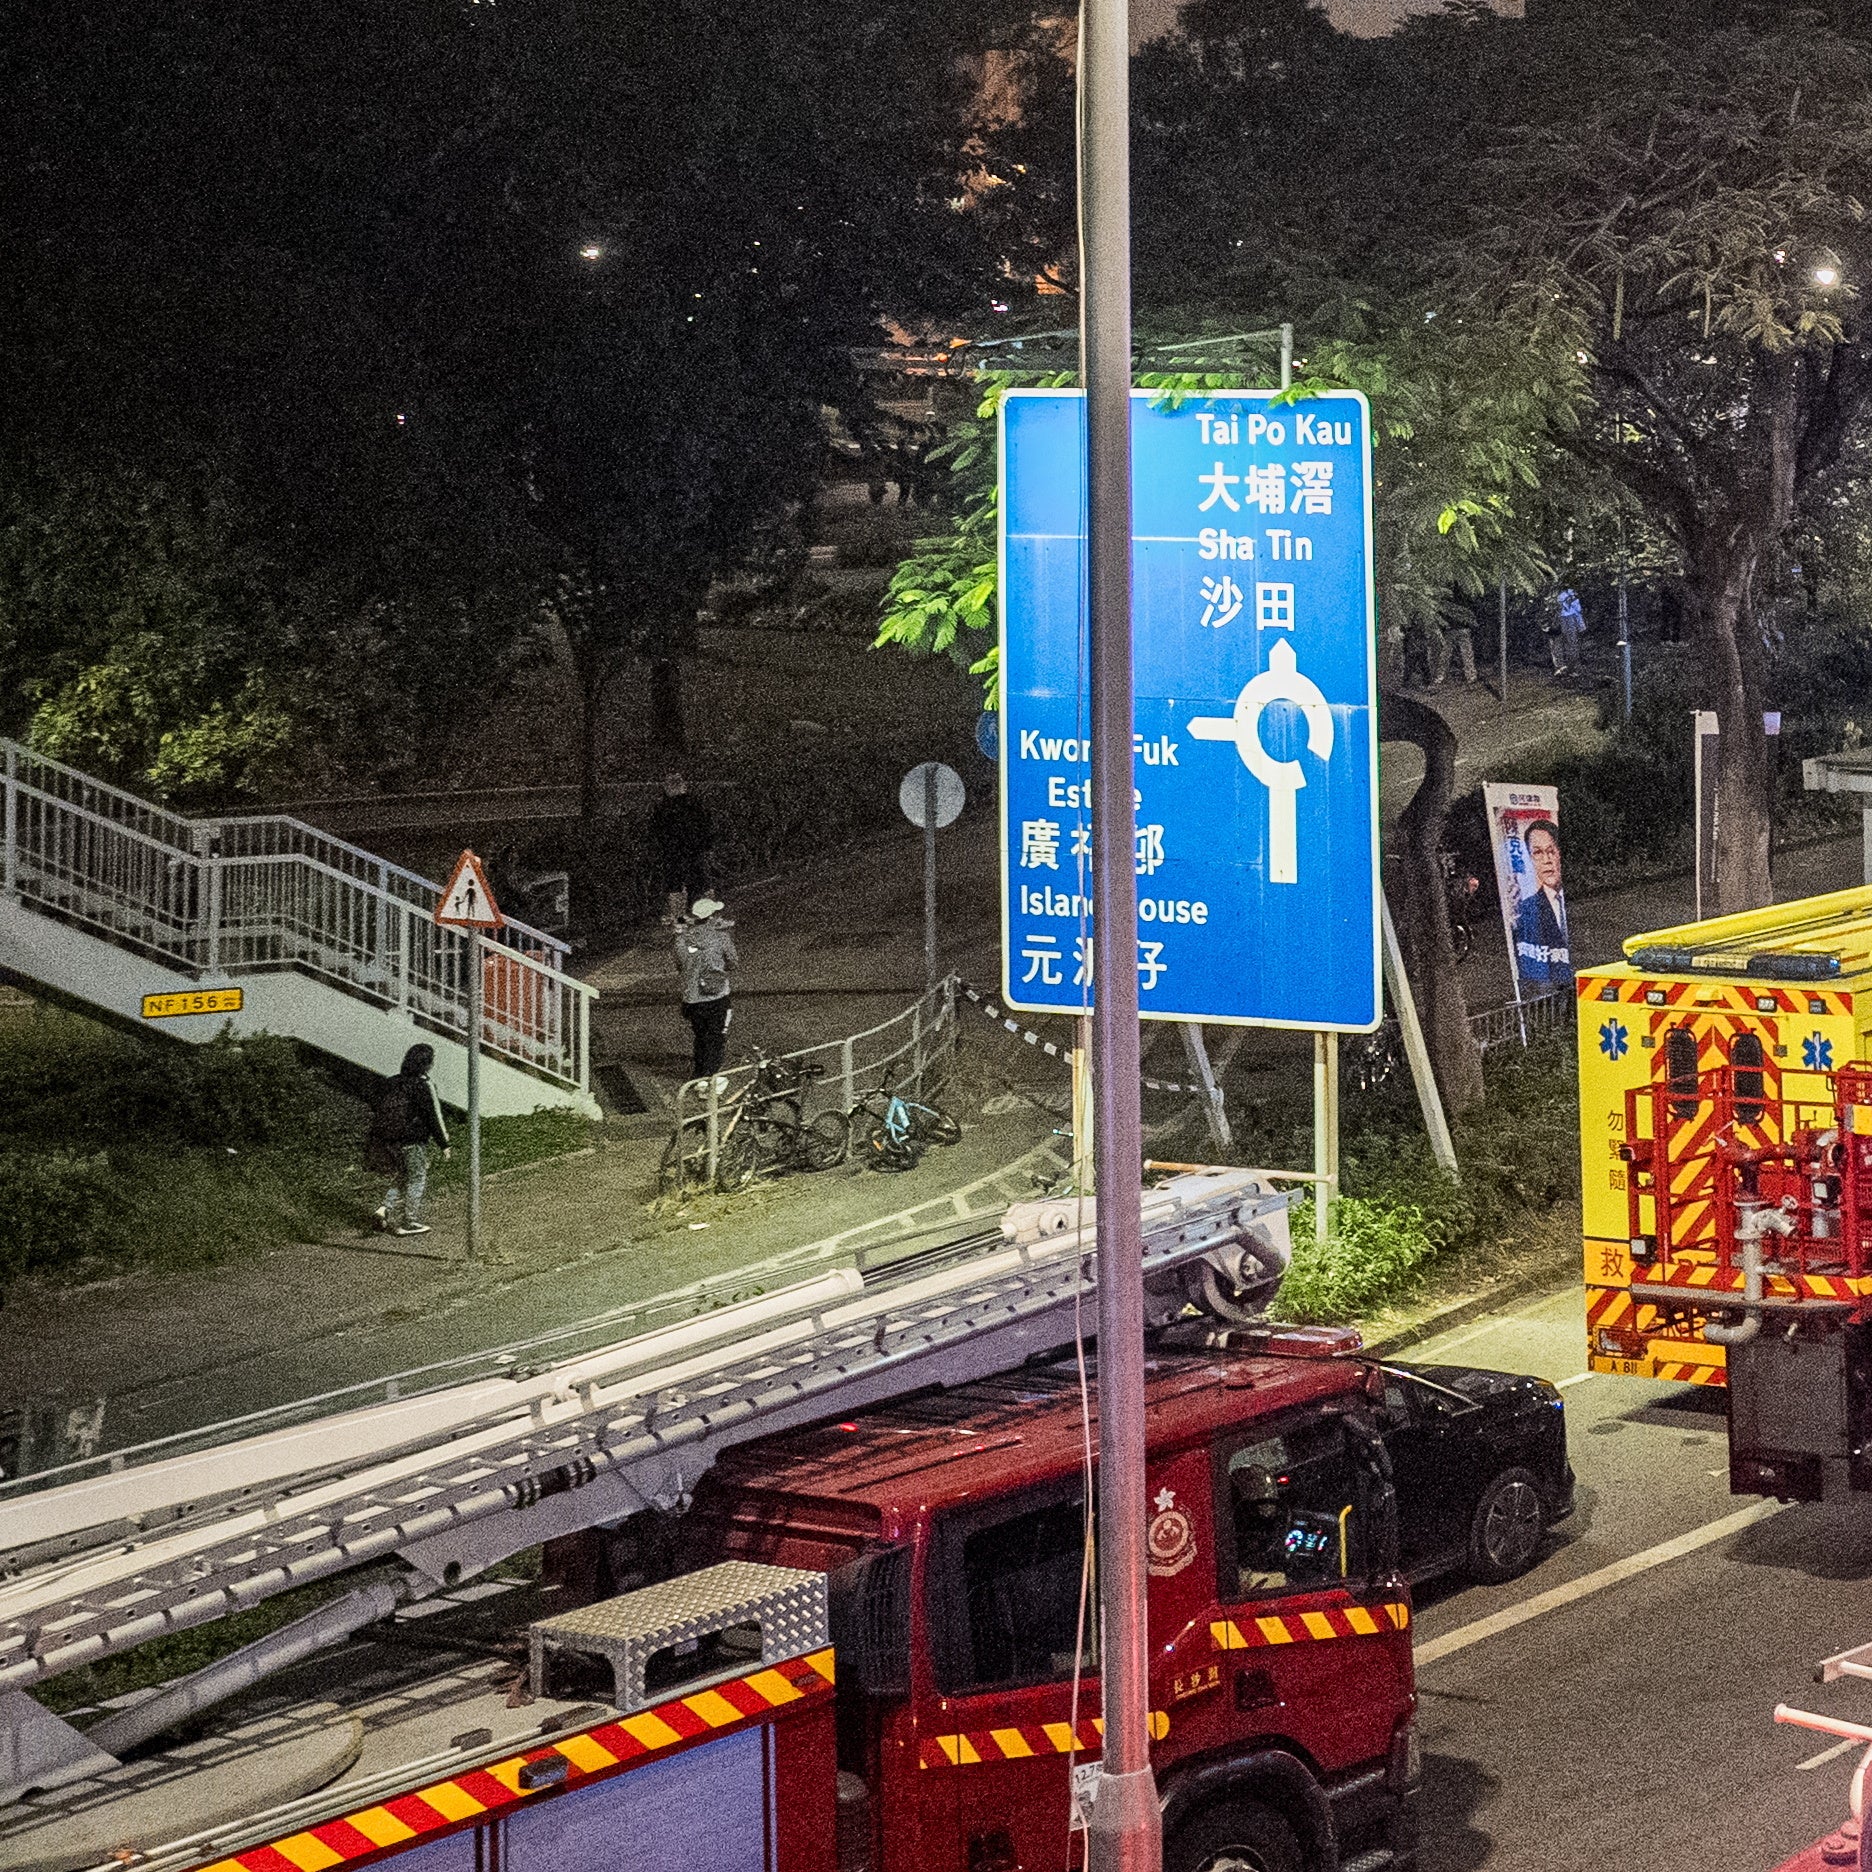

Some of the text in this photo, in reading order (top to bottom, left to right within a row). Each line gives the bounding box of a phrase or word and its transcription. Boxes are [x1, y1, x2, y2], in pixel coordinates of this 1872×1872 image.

[1195, 413, 1352, 446] Tai Po Kau
[1197, 461, 1334, 515] 大埔滘
[1198, 527, 1313, 561] Sha Tin
[1199, 575, 1295, 632] 沙田
[1138, 897, 1209, 925] ouse
[1601, 1247, 1625, 1278] 救
[1610, 1360, 1617, 1372] A
